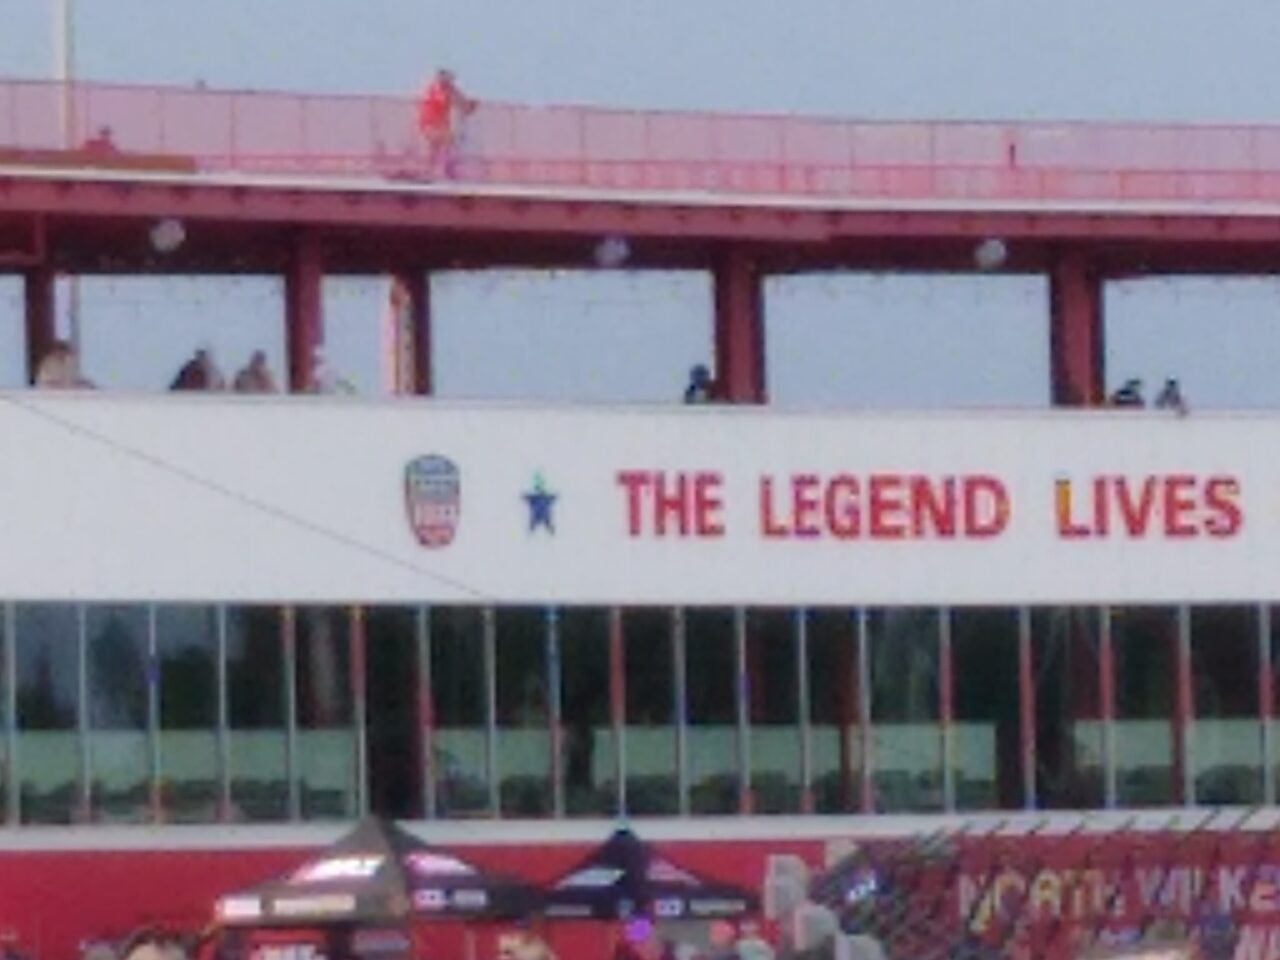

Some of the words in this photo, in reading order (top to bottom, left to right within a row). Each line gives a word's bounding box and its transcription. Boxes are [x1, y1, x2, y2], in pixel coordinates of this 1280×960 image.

[617, 471, 725, 538] THE
[760, 473, 1010, 540] LEGEND
[1054, 474, 1241, 538] LIVES
